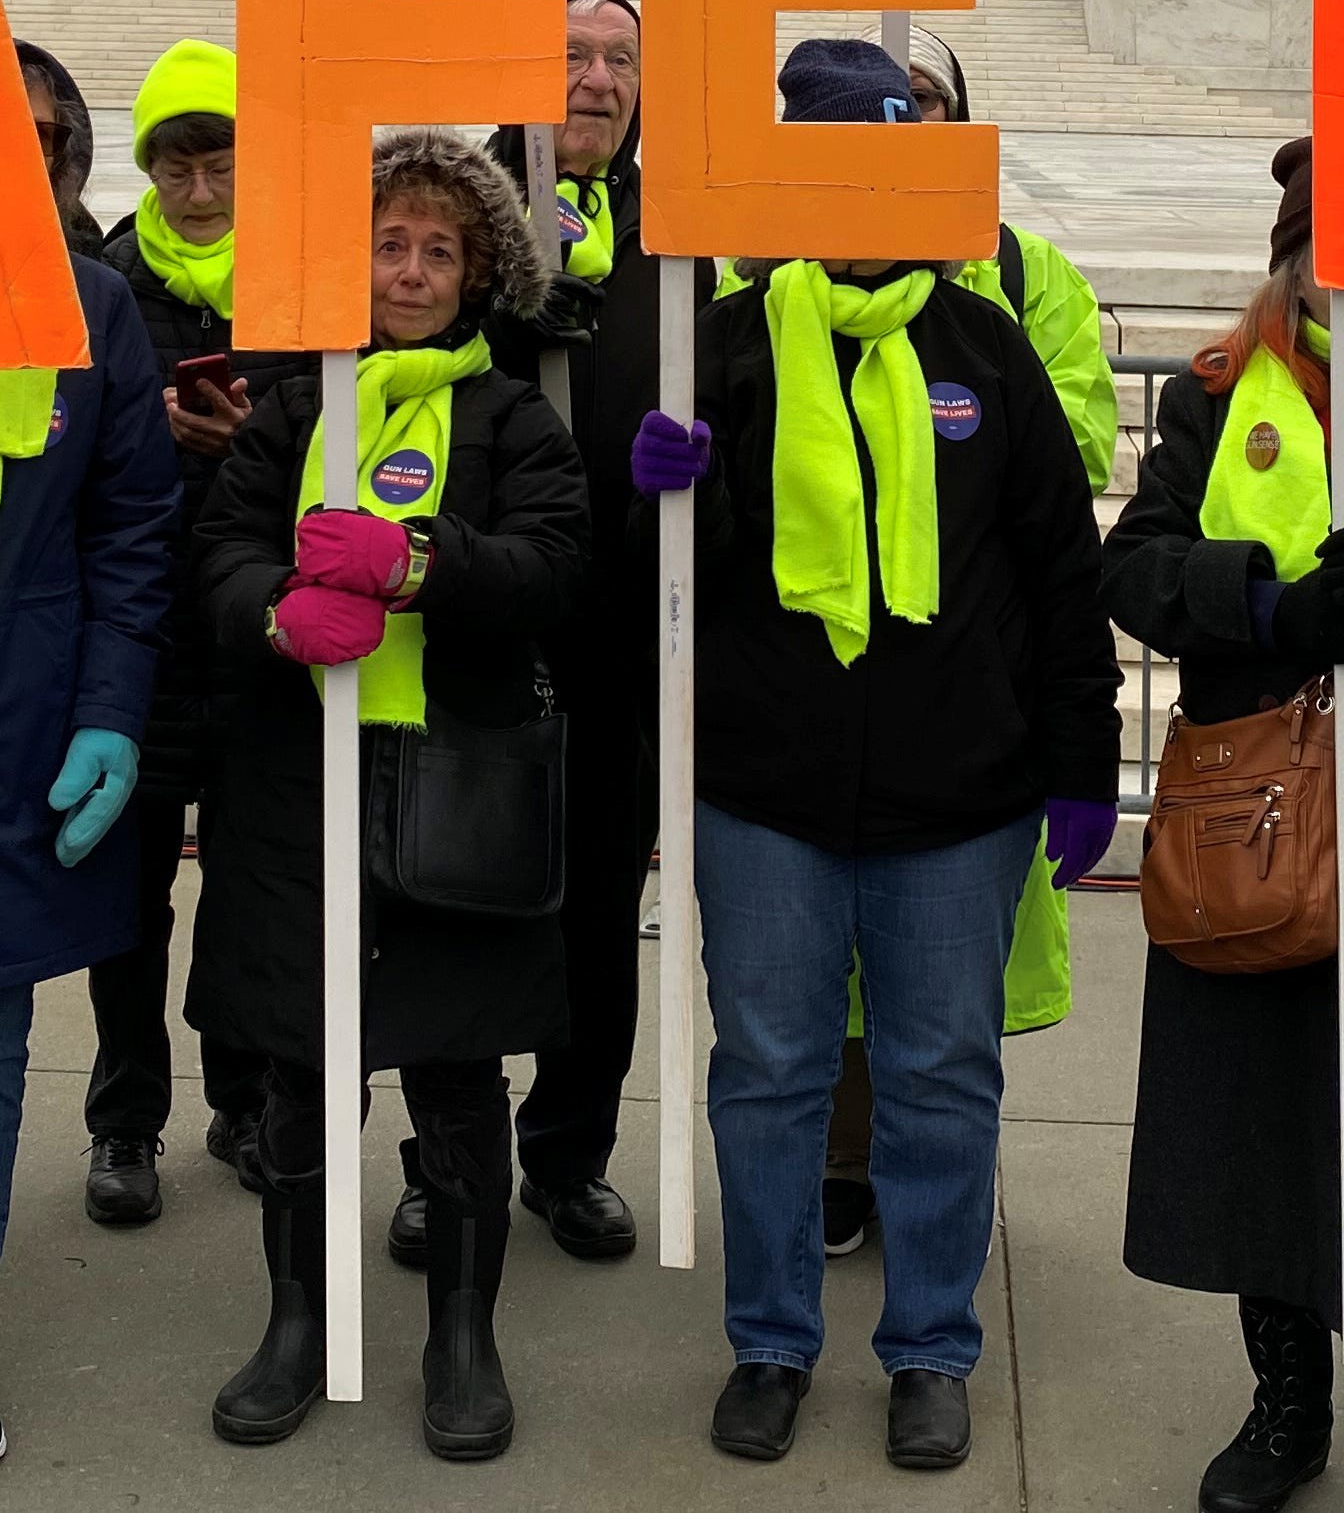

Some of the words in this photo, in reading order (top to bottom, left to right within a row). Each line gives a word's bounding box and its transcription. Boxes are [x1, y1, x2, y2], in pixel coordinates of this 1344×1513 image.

[946, 398, 971, 407] LAWS
[383, 464, 403, 473] GUN
[403, 467, 427, 476] LAWS
